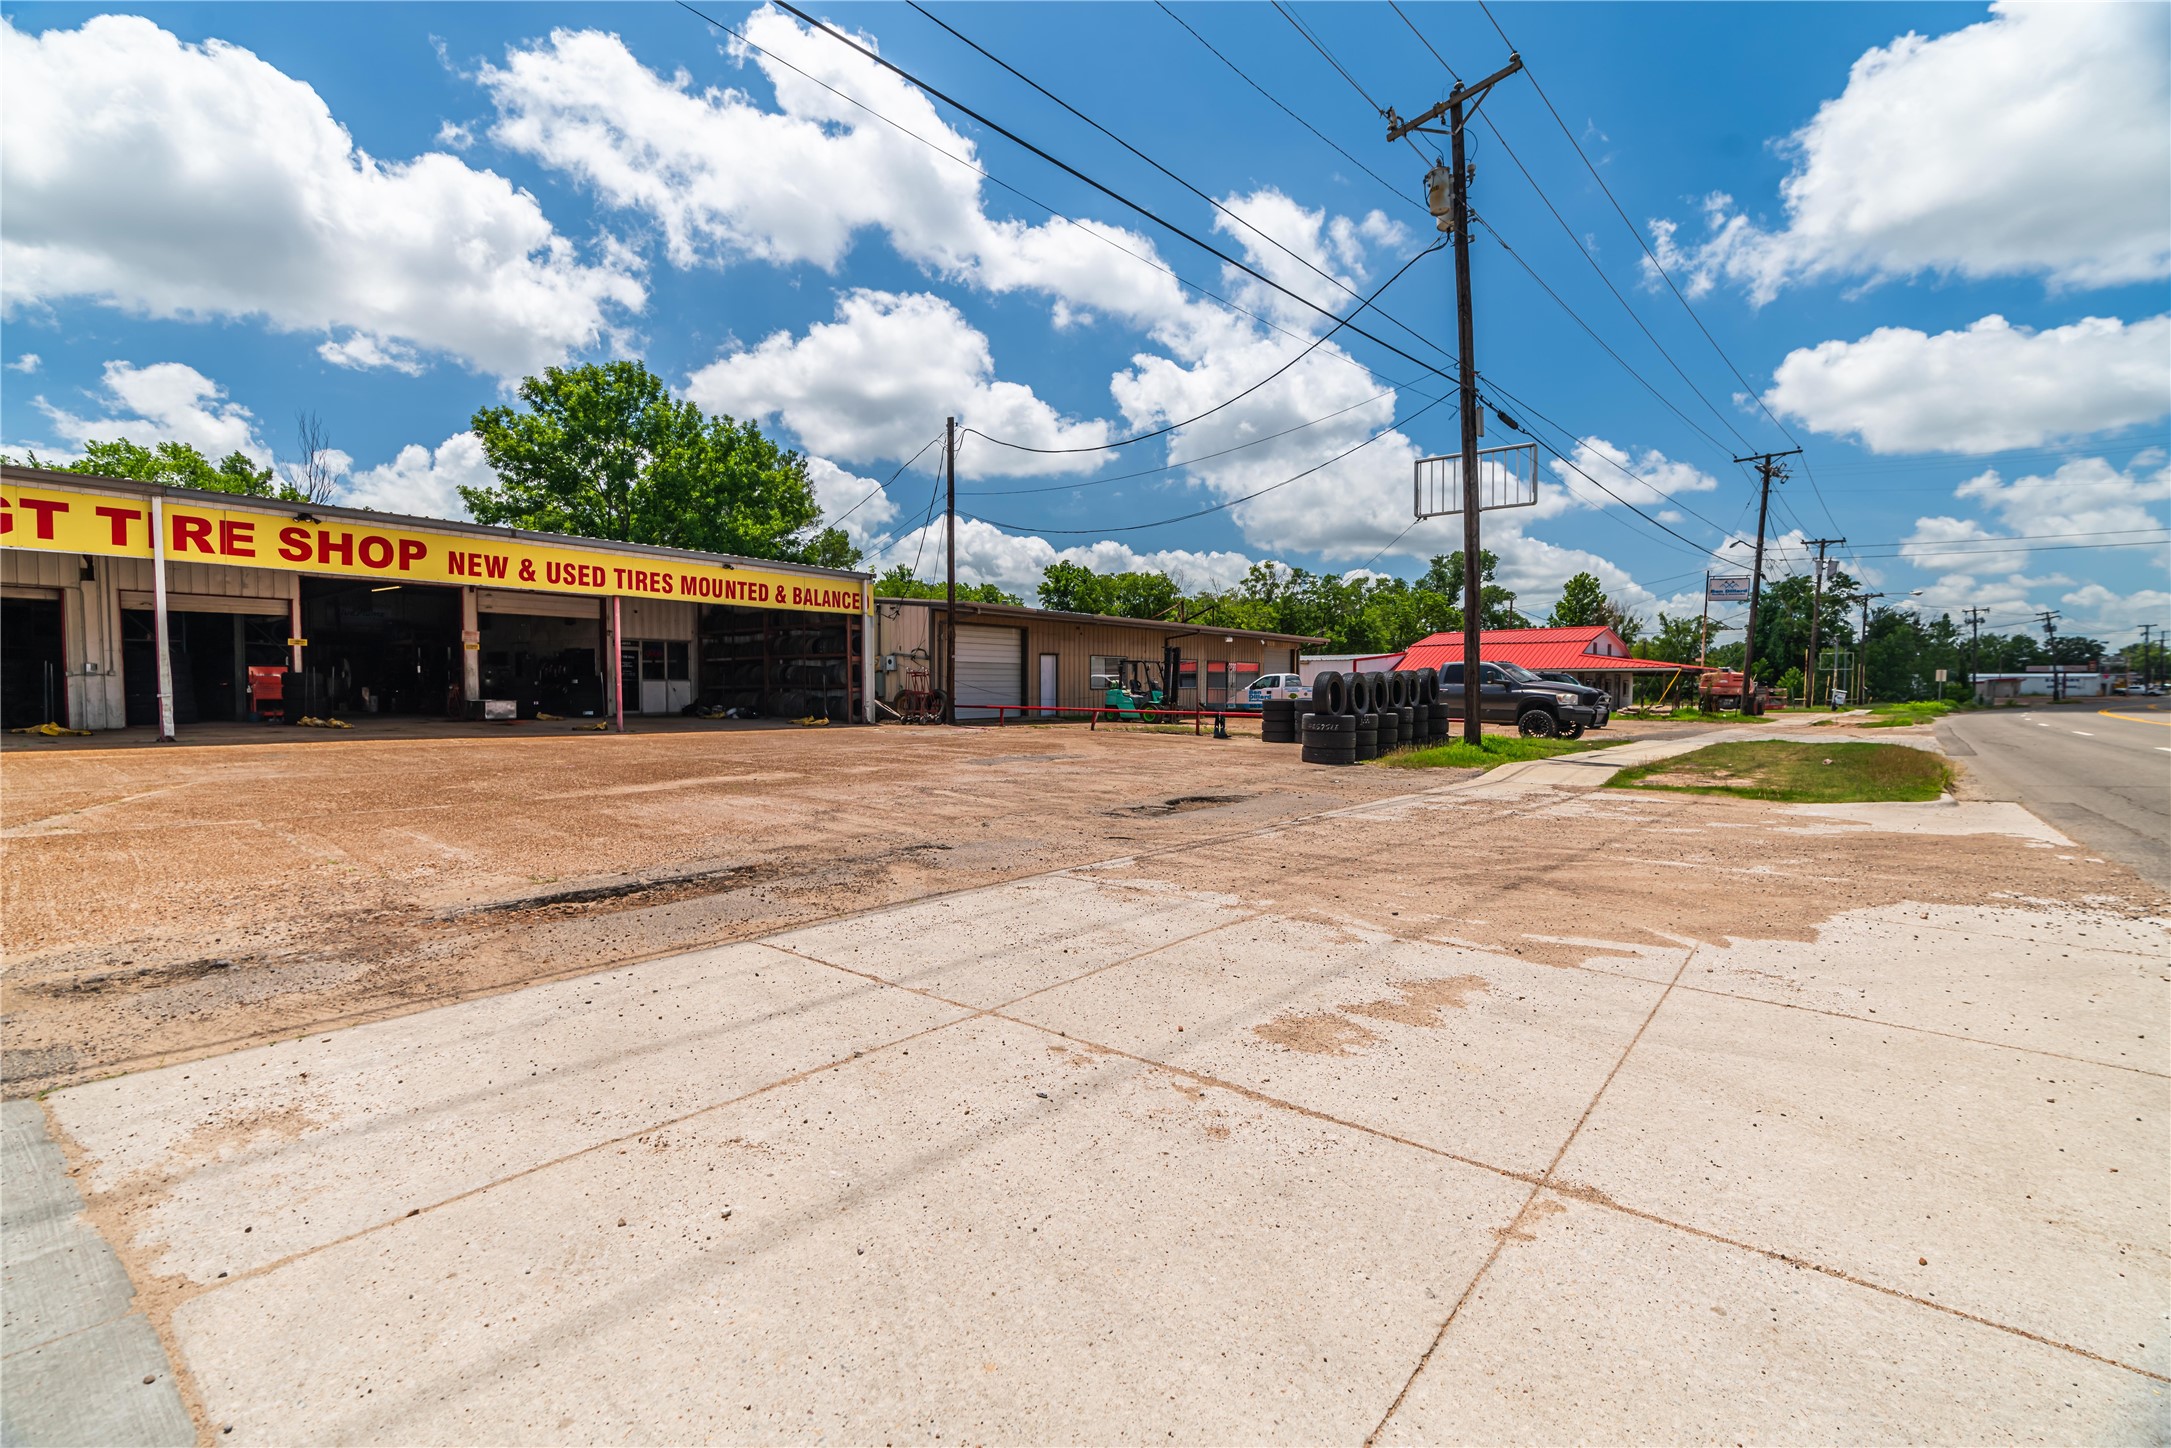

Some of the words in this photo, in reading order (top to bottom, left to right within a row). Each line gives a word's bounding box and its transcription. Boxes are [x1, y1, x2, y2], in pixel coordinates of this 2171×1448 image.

[0, 496, 69, 540] T
[278, 527, 427, 571] SHOP
[448, 551, 508, 579] NEW
[518, 558, 536, 582] &
[546, 561, 606, 588] USED
[613, 568, 673, 594] TIRES
[680, 575, 769, 602] MOUNTED
[774, 585, 787, 604] &
